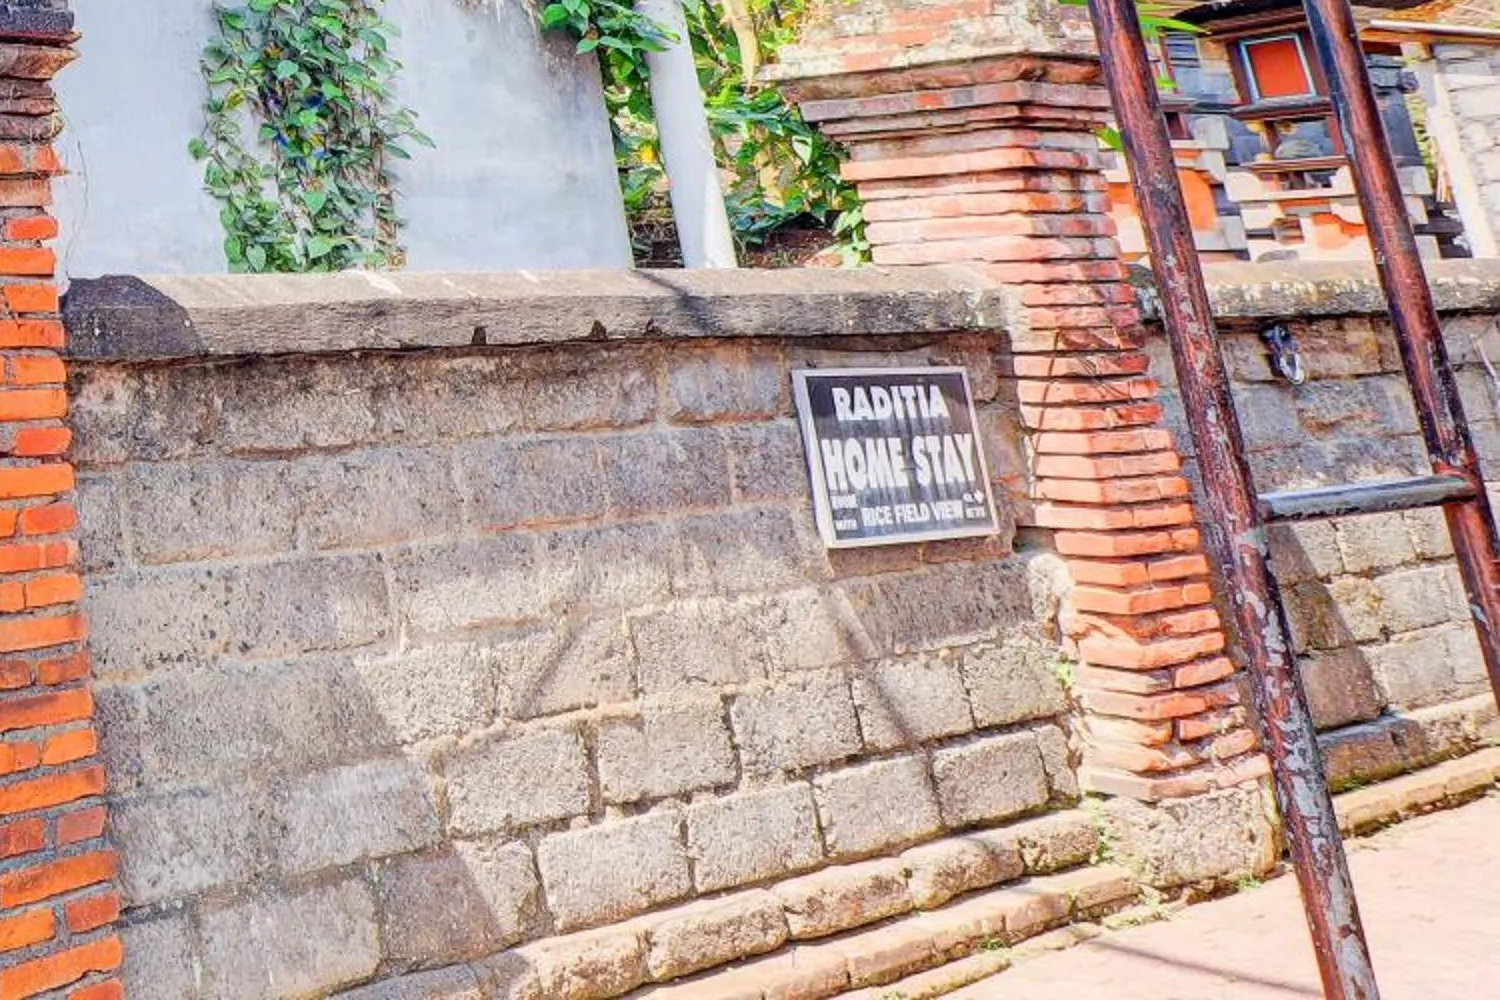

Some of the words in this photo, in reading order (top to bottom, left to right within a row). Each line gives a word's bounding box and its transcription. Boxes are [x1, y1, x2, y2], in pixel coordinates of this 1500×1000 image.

[831, 385, 950, 421] RADITIA
[820, 437, 909, 491] HOME
[912, 433, 977, 487] STAY
[860, 505, 894, 527] RICE
[894, 502, 931, 524] FIELD
[931, 500, 964, 521] VIEW
